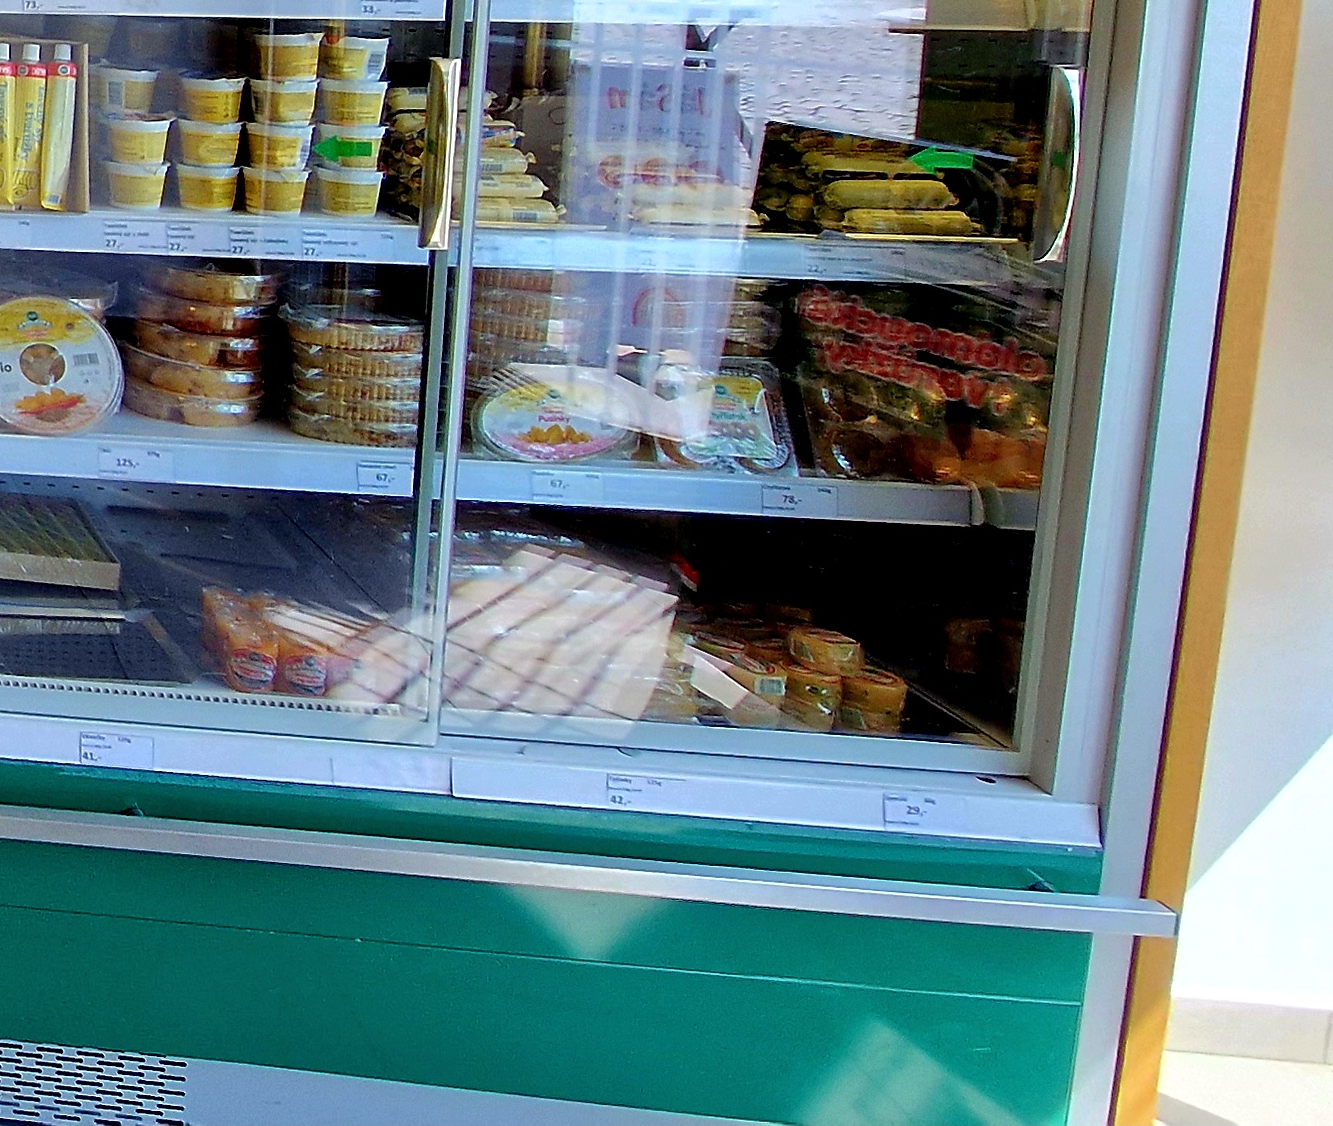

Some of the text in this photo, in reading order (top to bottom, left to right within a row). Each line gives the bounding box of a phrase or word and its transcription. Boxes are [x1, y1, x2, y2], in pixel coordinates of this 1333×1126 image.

[105, 239, 124, 249] 27,-
[169, 242, 187, 253] 27,-
[232, 245, 250, 255] 27,-
[304, 247, 322, 257] 27,-
[116, 458, 140, 469] 125,-
[376, 473, 395, 483] 67,-
